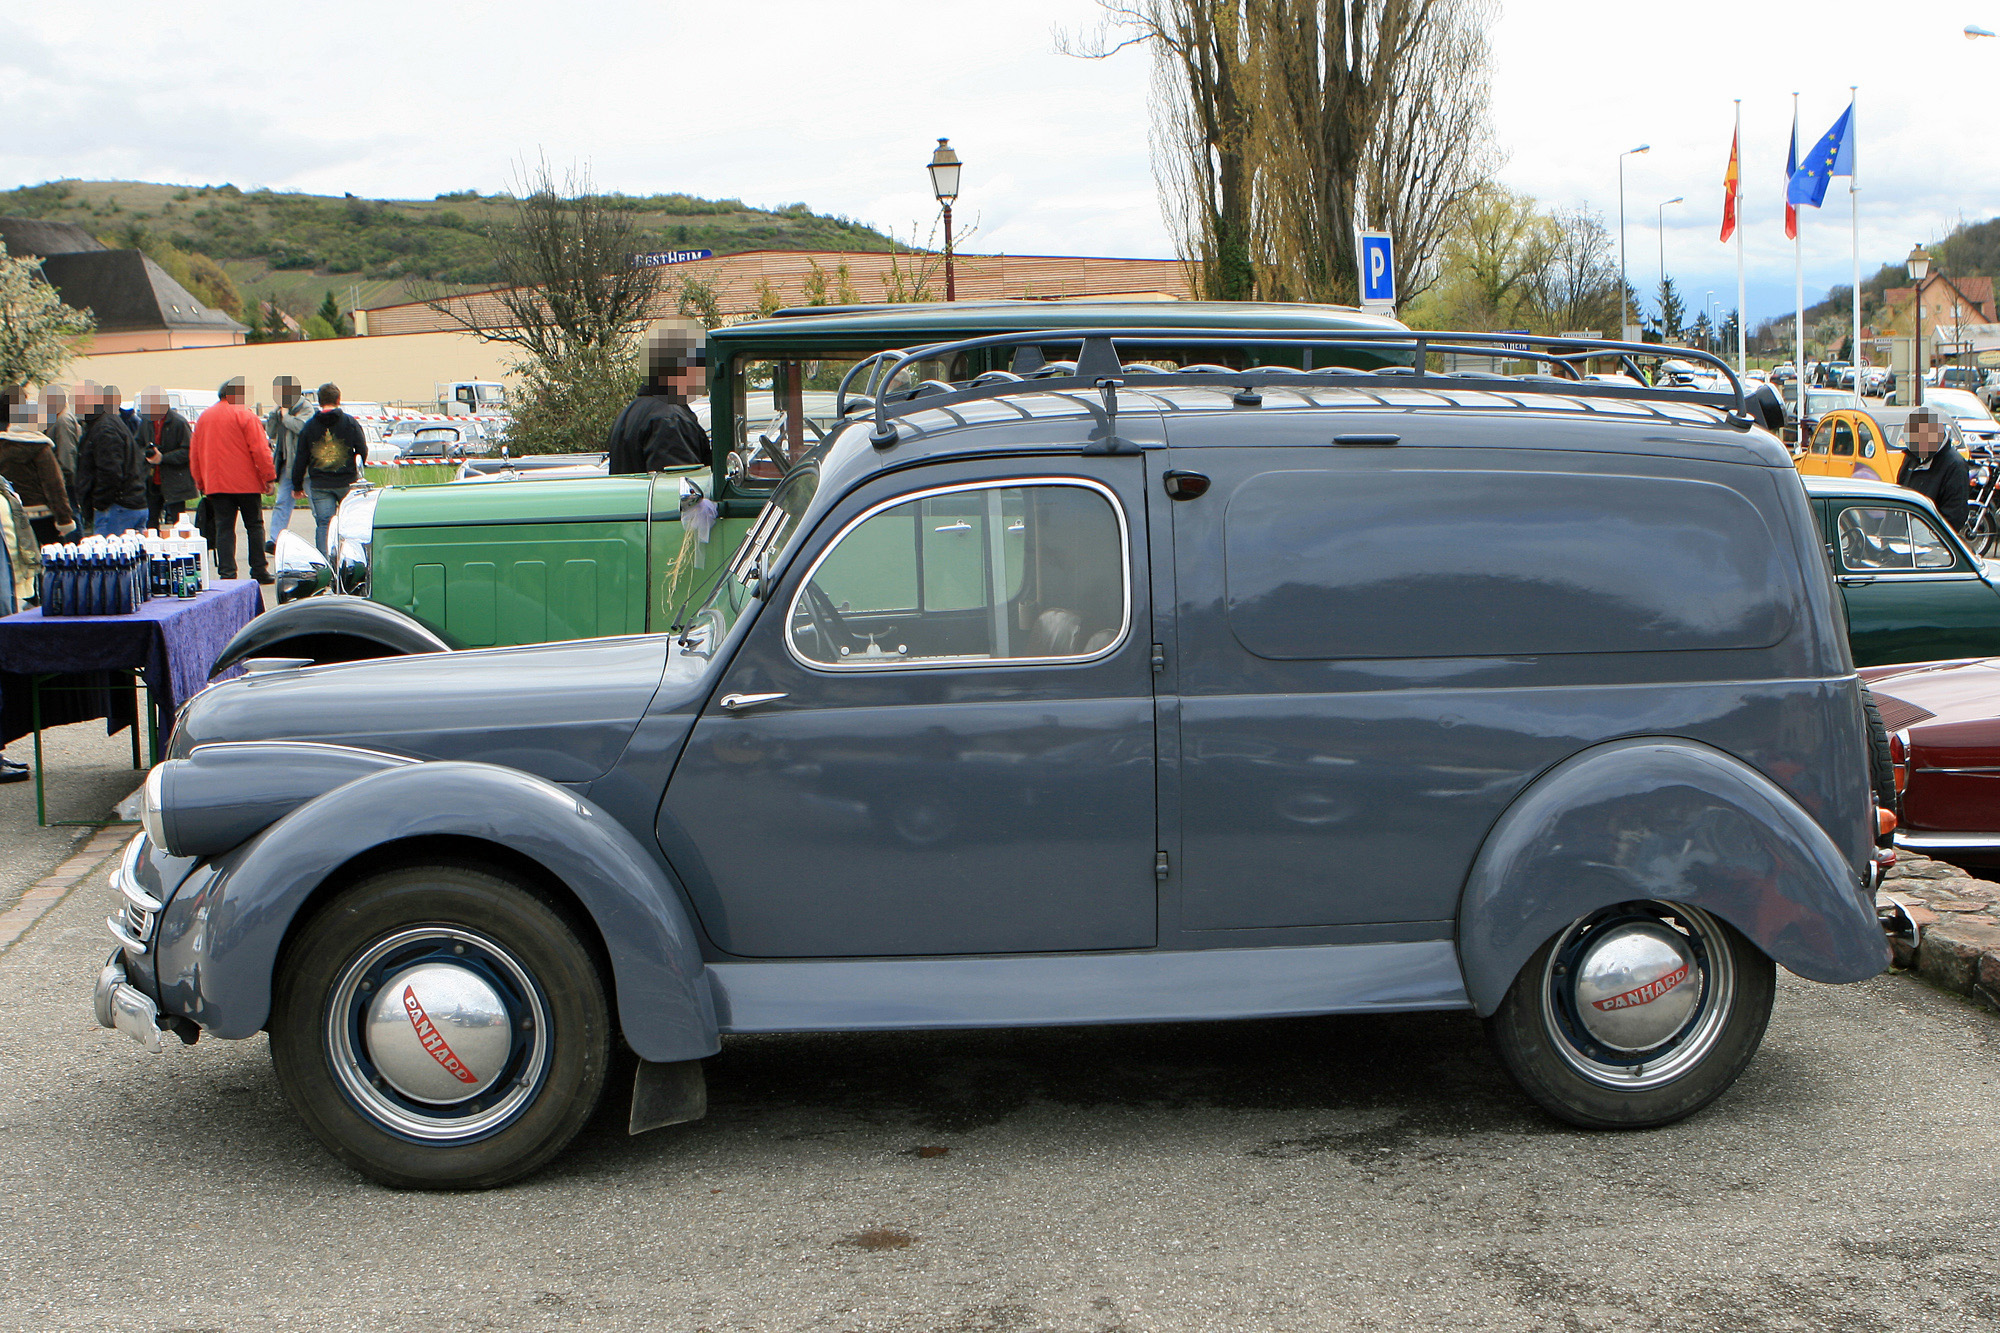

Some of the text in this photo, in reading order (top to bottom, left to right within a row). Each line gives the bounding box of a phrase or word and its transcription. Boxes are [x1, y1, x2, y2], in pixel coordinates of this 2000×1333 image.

[1370, 246, 1385, 290] P
[1602, 970, 1685, 1010] PANHARD
[405, 995, 468, 1080] PANHARD
